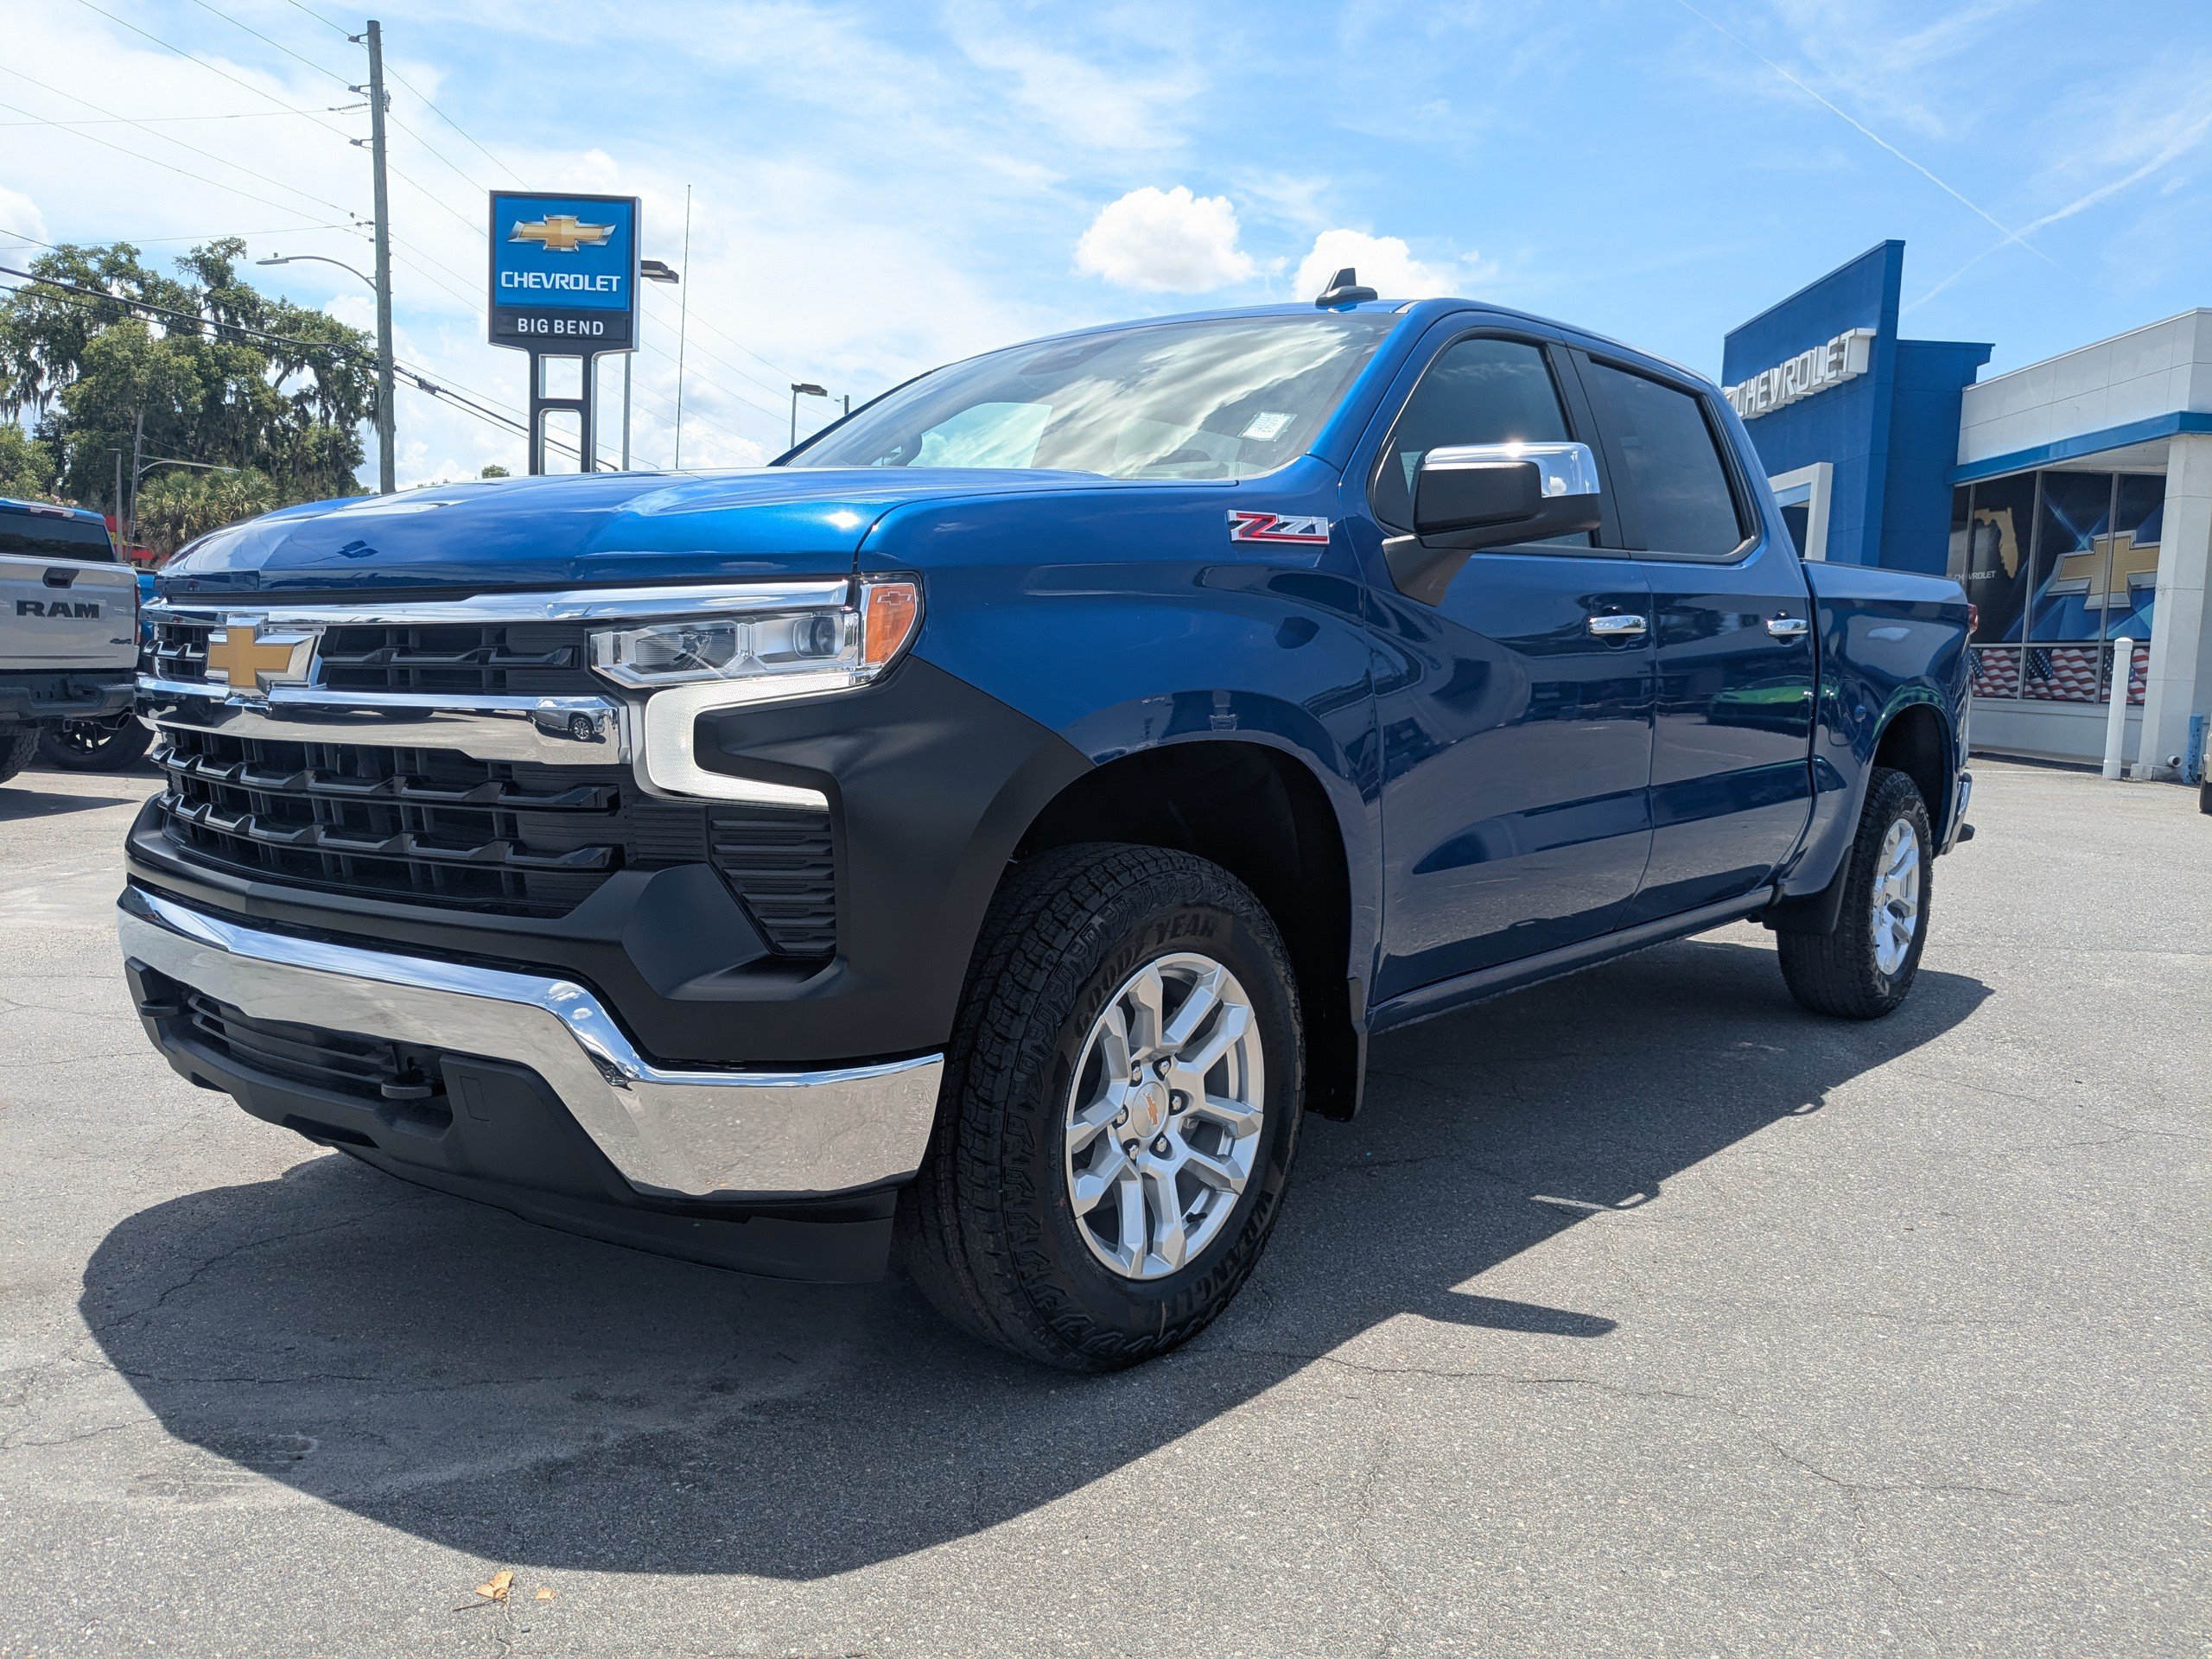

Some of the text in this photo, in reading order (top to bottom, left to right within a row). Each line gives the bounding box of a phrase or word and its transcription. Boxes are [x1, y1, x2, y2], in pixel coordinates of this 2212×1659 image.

[500, 271, 621, 292] CHEVROLET
[518, 318, 604, 335] BIG BEND
[1734, 327, 1873, 419] CHEVROLET
[1227, 509, 1331, 545] Z71
[1954, 570, 1996, 582] CHVROLET
[16, 600, 100, 619] RAM
